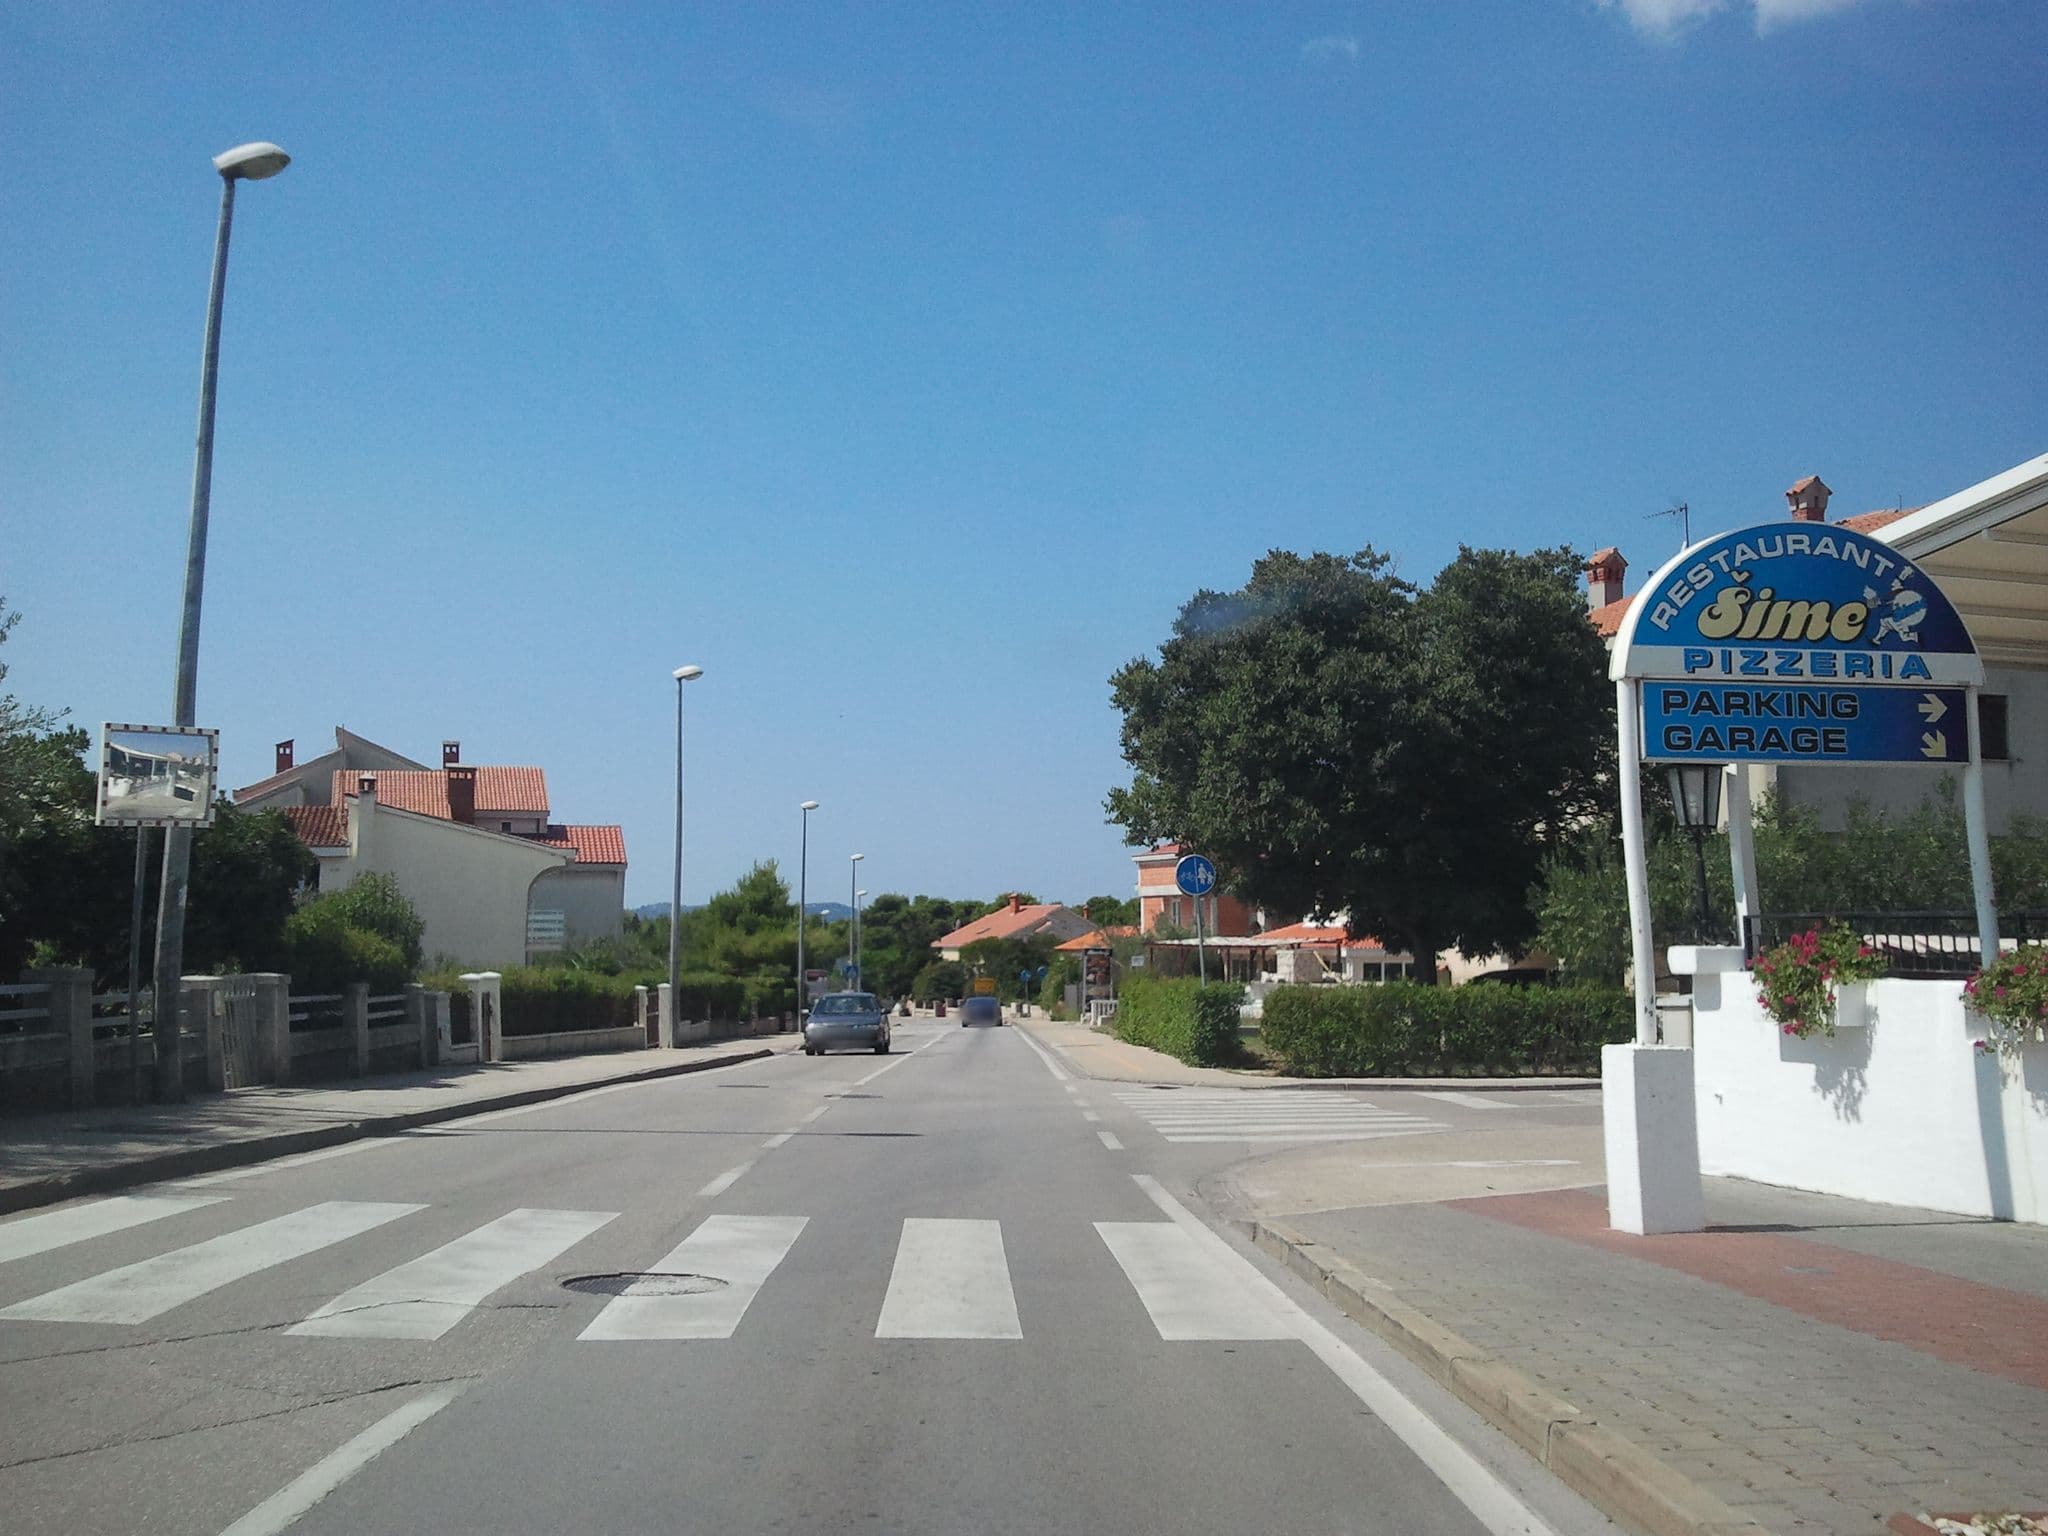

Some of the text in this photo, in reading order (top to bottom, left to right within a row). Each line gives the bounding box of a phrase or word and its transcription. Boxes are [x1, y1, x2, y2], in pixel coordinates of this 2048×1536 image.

[1650, 533, 1895, 632] RESTAURANT
[1697, 569, 1868, 641] Šime
[1683, 647, 1932, 680] PIZZERIA
[1661, 689, 1860, 719] PARKING
[1663, 725, 1848, 754] GARAGE
